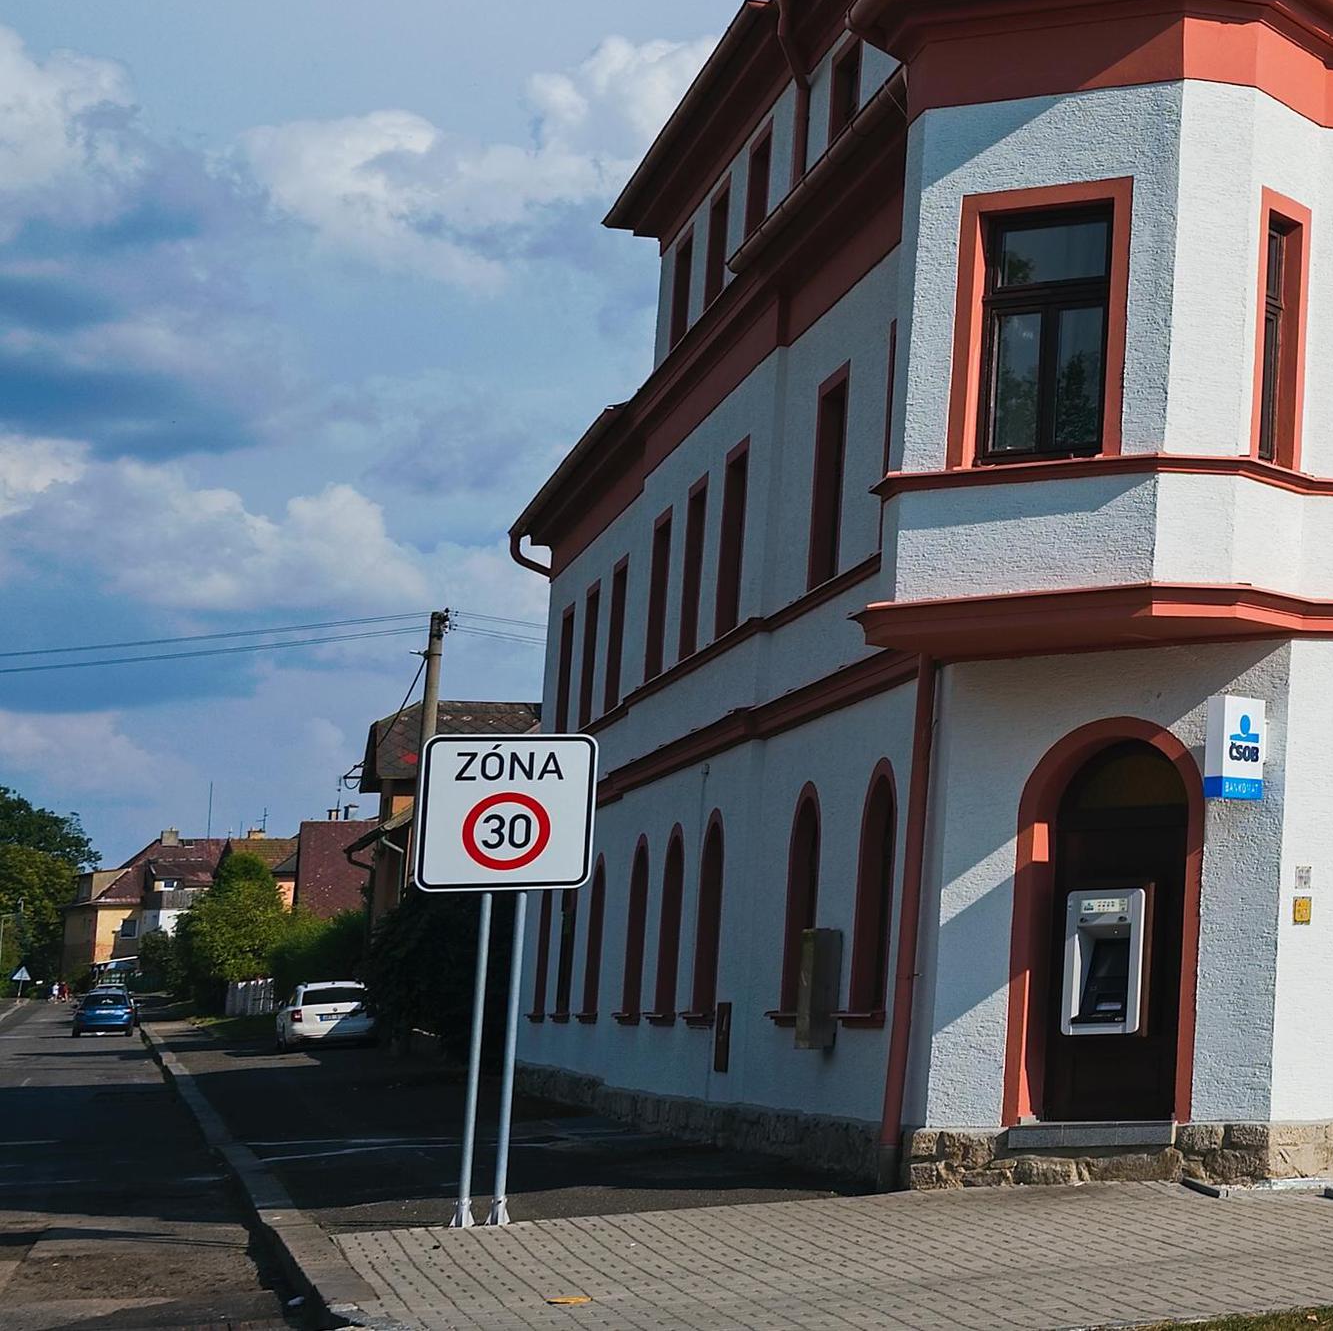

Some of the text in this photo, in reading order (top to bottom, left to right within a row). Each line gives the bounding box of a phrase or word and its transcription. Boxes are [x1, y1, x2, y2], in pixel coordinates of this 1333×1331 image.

[455, 743, 564, 781] ZÓNA
[1229, 741, 1259, 762] ČSOB
[481, 813, 532, 850] 30
